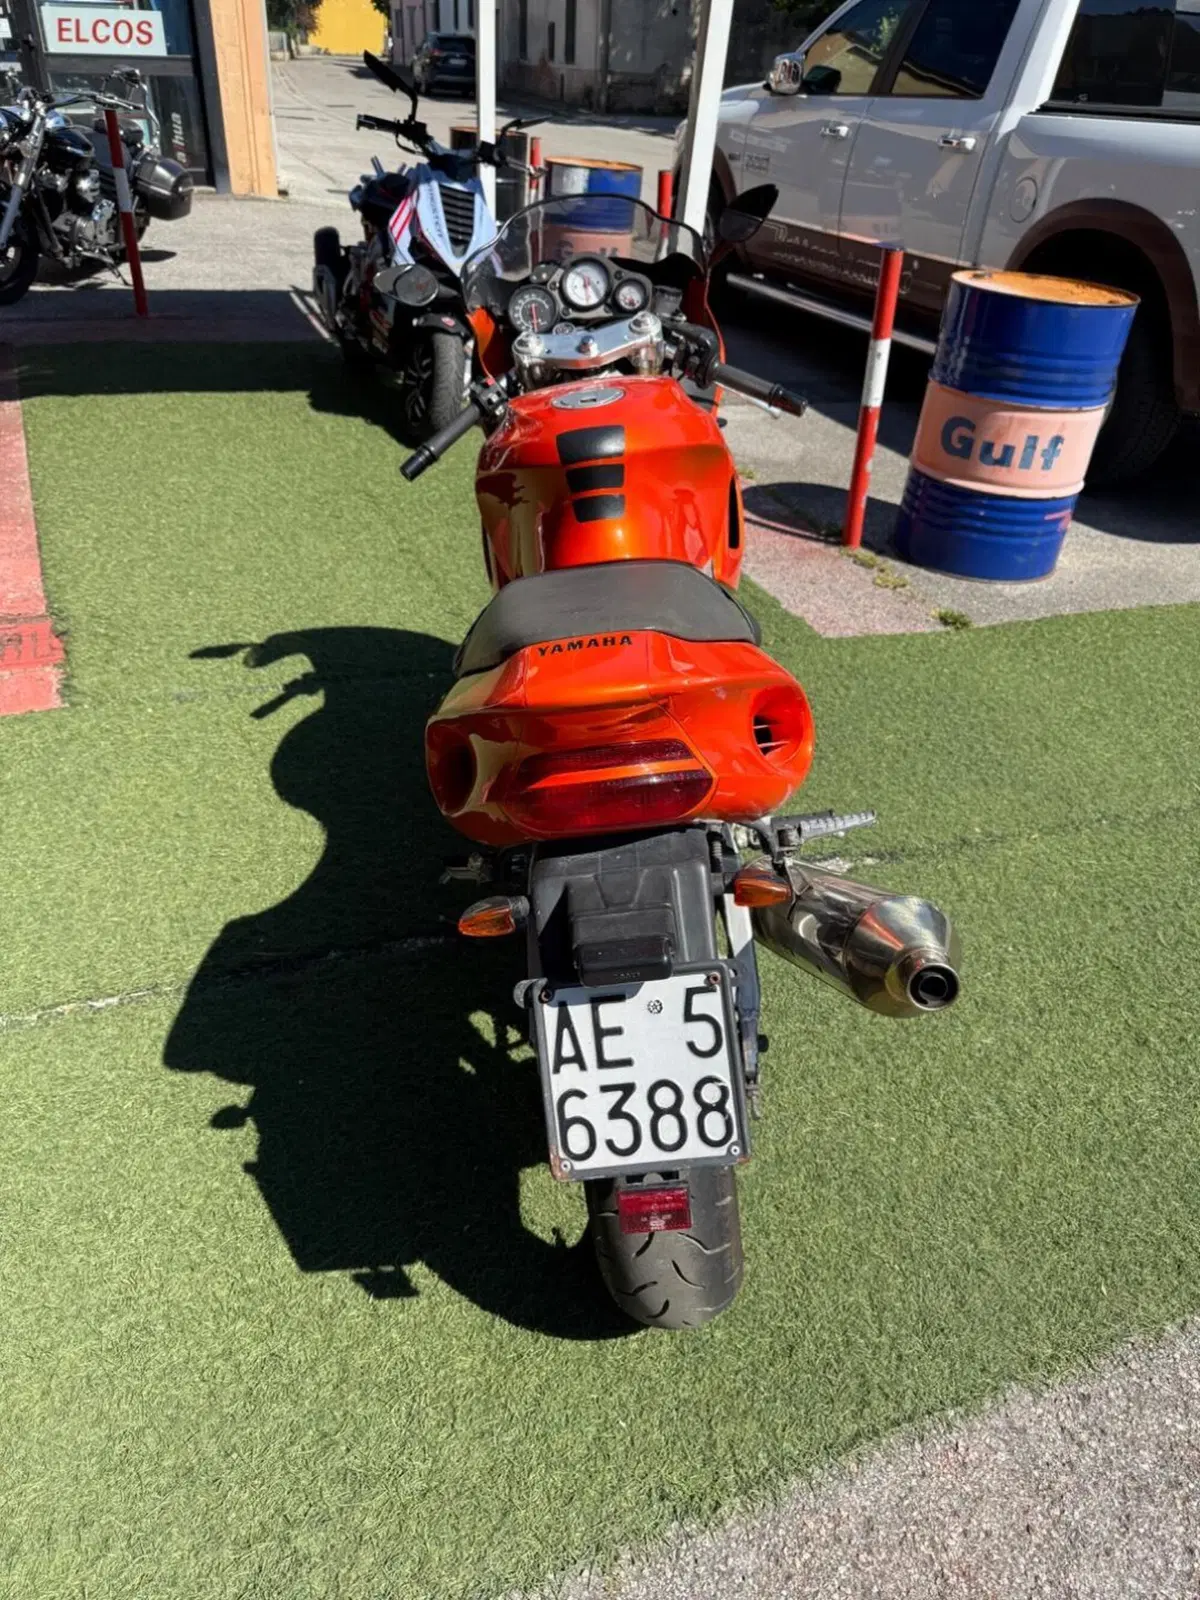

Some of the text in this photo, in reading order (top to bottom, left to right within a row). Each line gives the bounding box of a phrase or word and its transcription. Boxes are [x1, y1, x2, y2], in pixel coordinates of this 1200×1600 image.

[57, 18, 153, 45] ELCOS
[941, 415, 1065, 470] Gulf
[538, 635, 632, 656] YAMAHA
[553, 986, 723, 1074] AE 5
[556, 1075, 734, 1161] 6388
